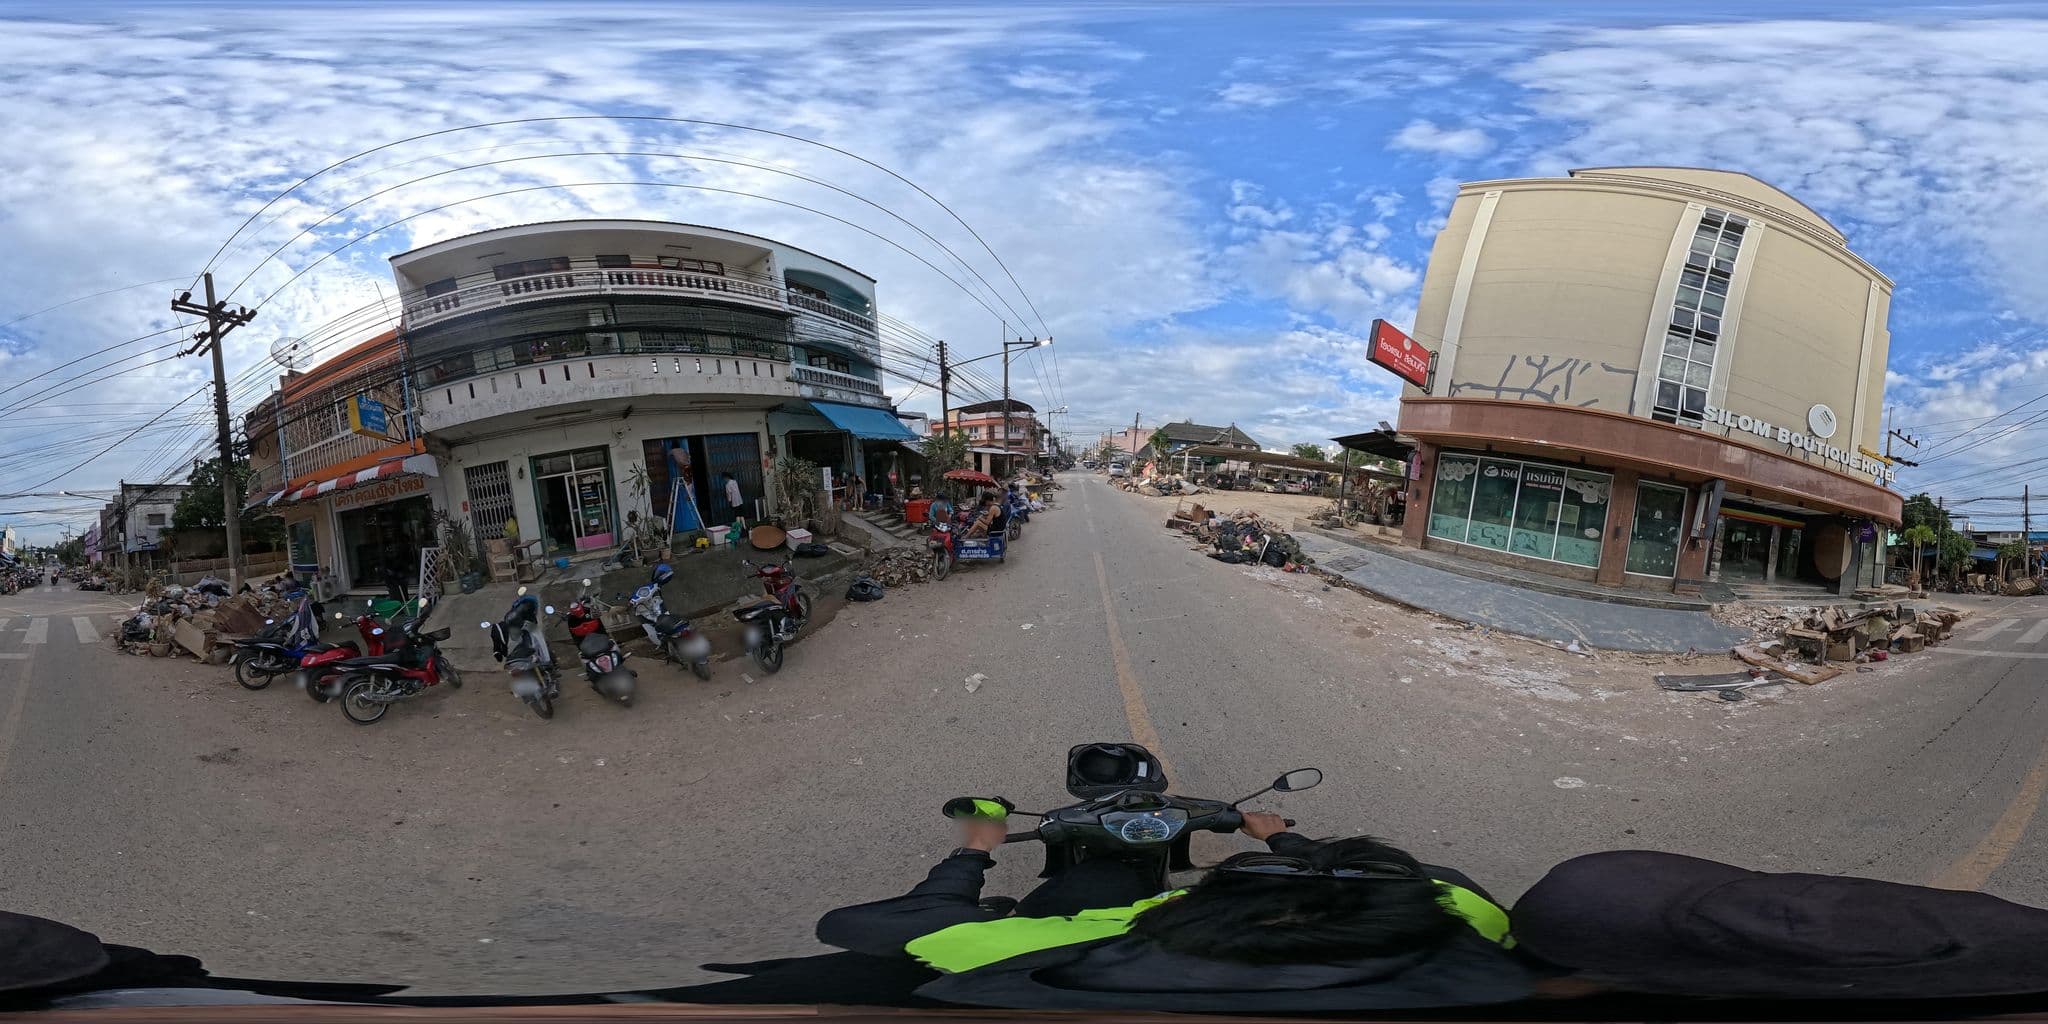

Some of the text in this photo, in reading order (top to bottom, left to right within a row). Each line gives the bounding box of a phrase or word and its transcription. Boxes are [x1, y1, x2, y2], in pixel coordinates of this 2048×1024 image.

[1702, 405, 1771, 438] SILOM
[1777, 427, 1862, 469] BOUTIQUE
[1861, 455, 1897, 483] HOTEL
